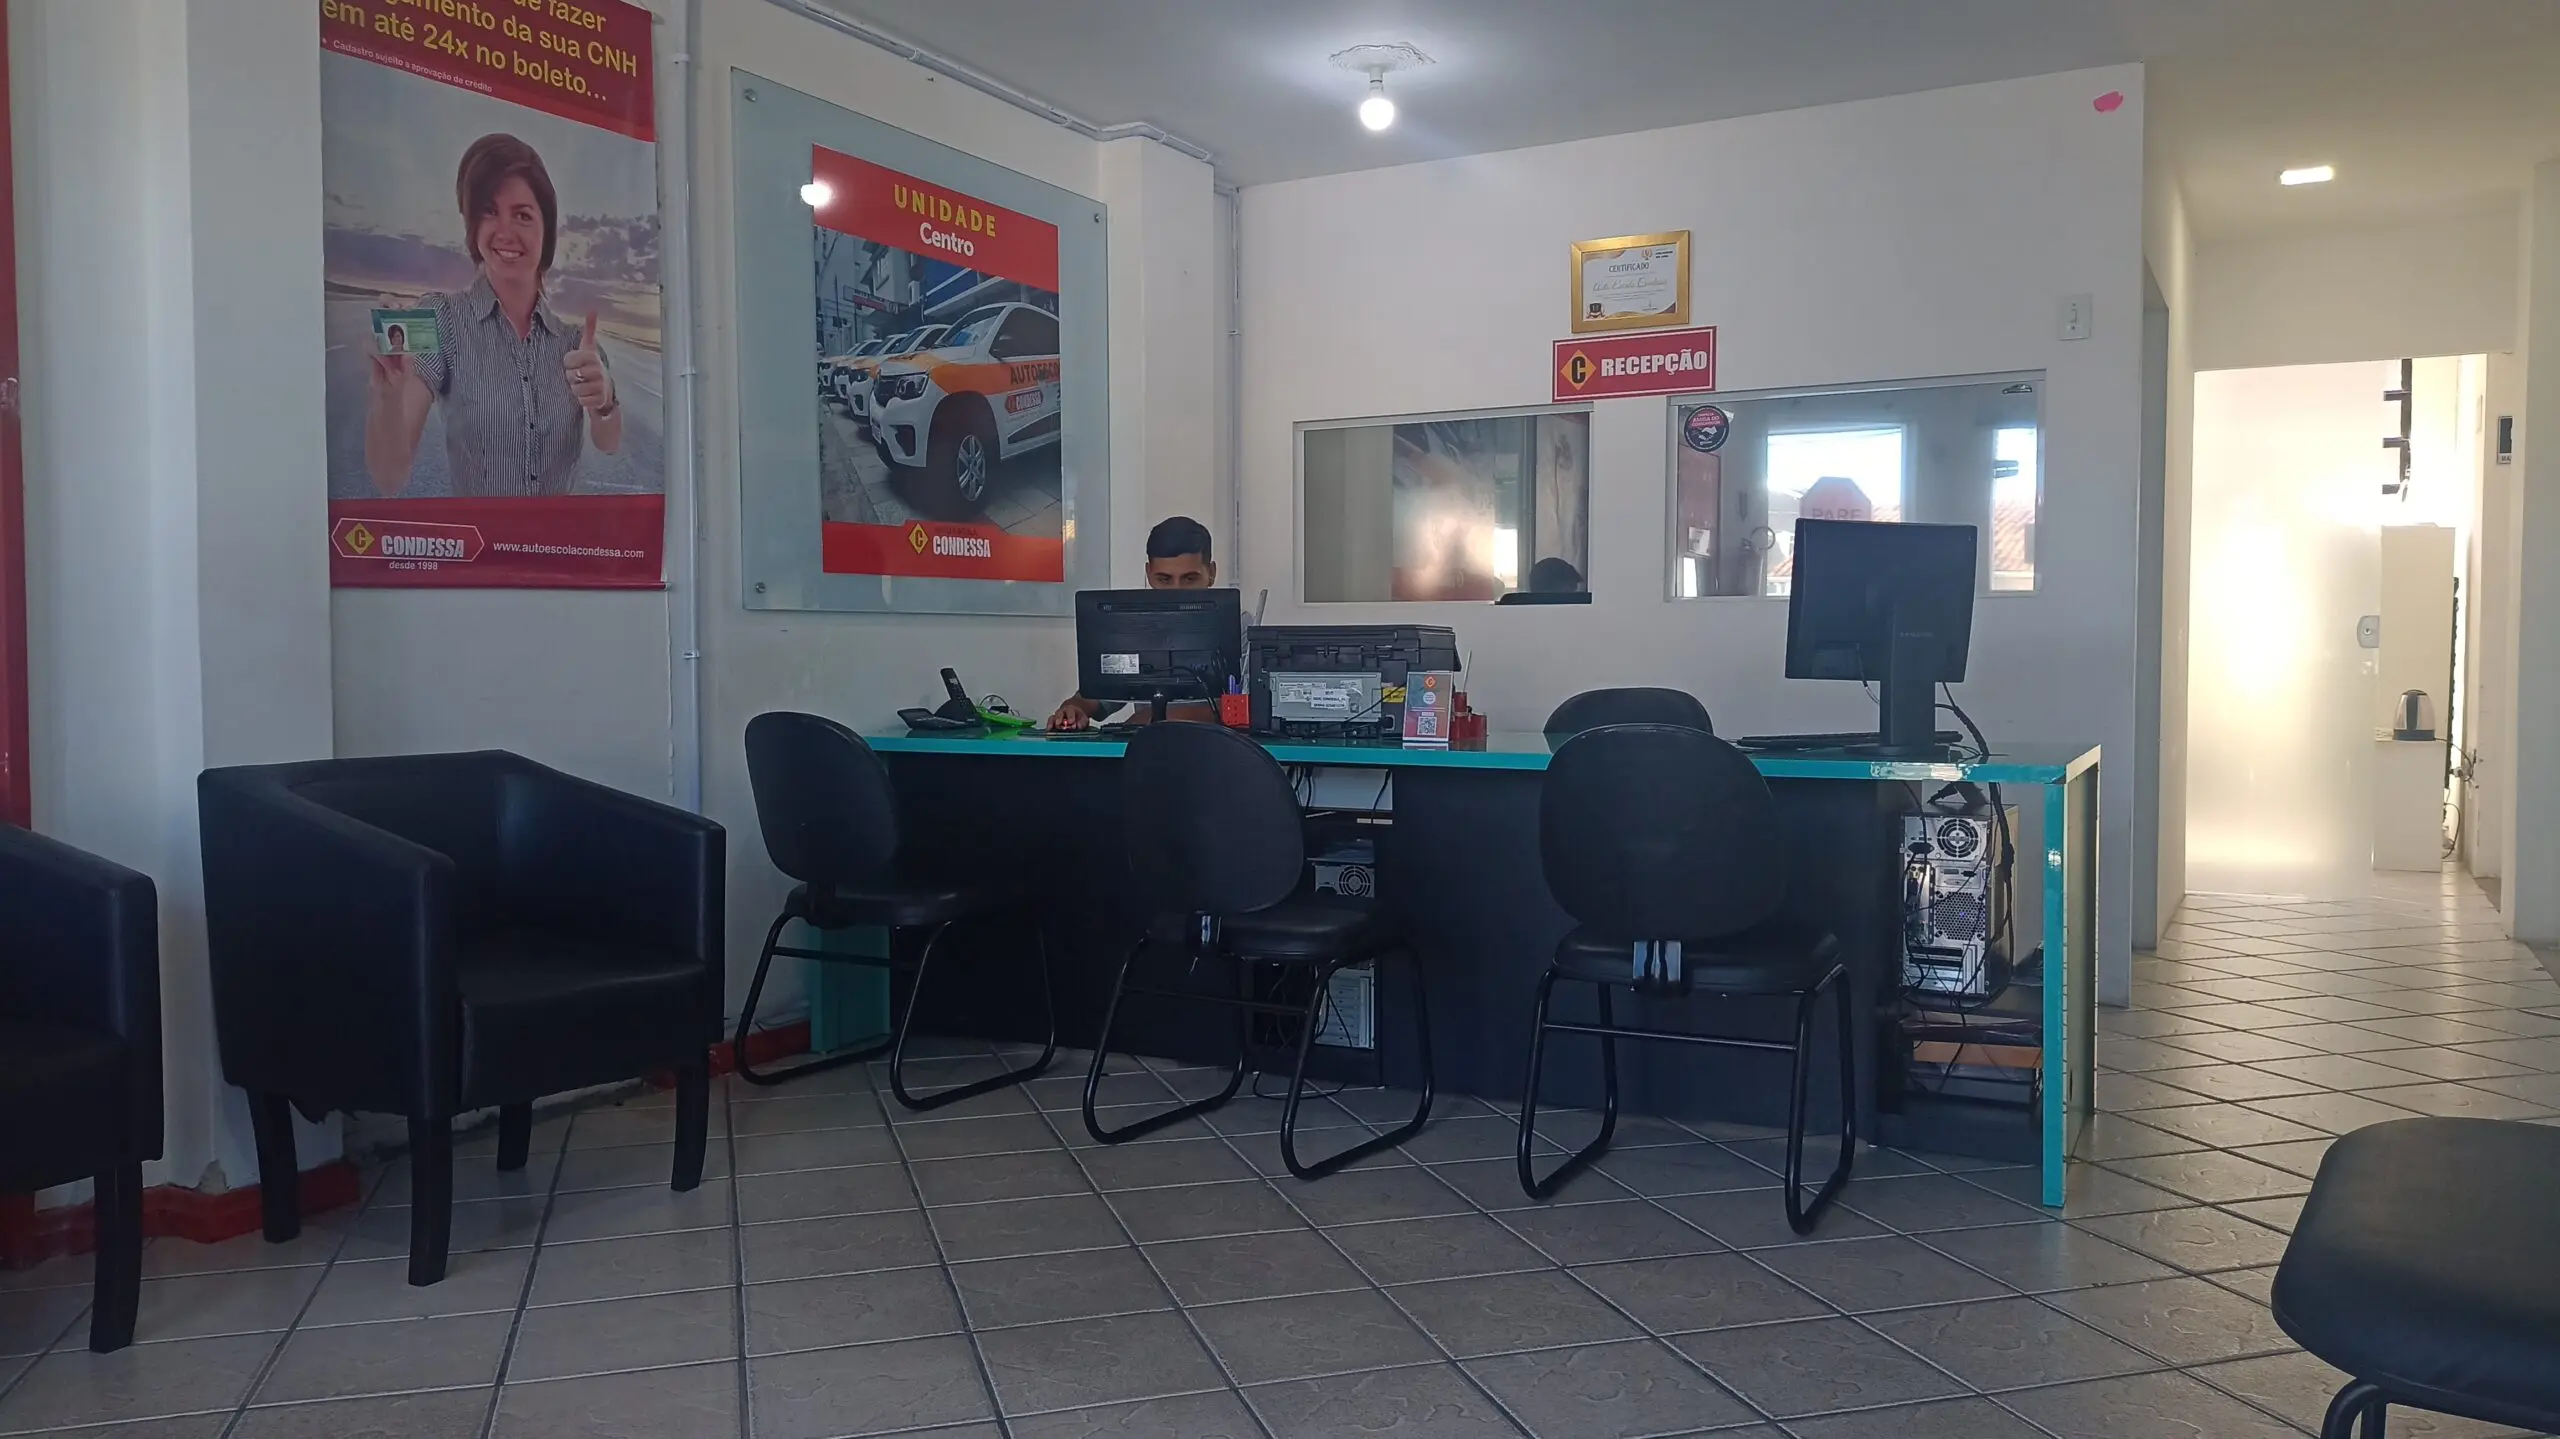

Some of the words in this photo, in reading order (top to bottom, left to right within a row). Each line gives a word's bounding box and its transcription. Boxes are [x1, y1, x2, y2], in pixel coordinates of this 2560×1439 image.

[322, 0, 365, 27] em
[374, 12, 415, 42] até
[423, 23, 469, 59] 24x
[476, 44, 506, 70] no
[513, 50, 607, 101] boleto...
[333, 39, 374, 58] Cadastro
[375, 52, 404, 68] sujeito
[405, 61, 411, 69] a
[411, 63, 452, 82] aprovação
[503, 15, 533, 43] da
[539, 31, 581, 59] sua
[587, 41, 637, 77] CNH
[894, 183, 996, 238] UNIDADE
[920, 222, 975, 257] Centro
[1608, 261, 1650, 273] CERTIFICADO
[1601, 348, 1708, 376] RECEPÇÃO
[381, 535, 465, 558] CONDESSA
[493, 542, 645, 559] www.autoescolacondessa.com
[932, 535, 992, 558] CONDESSA
[389, 560, 416, 570] desde
[417, 561, 438, 571] 1998
